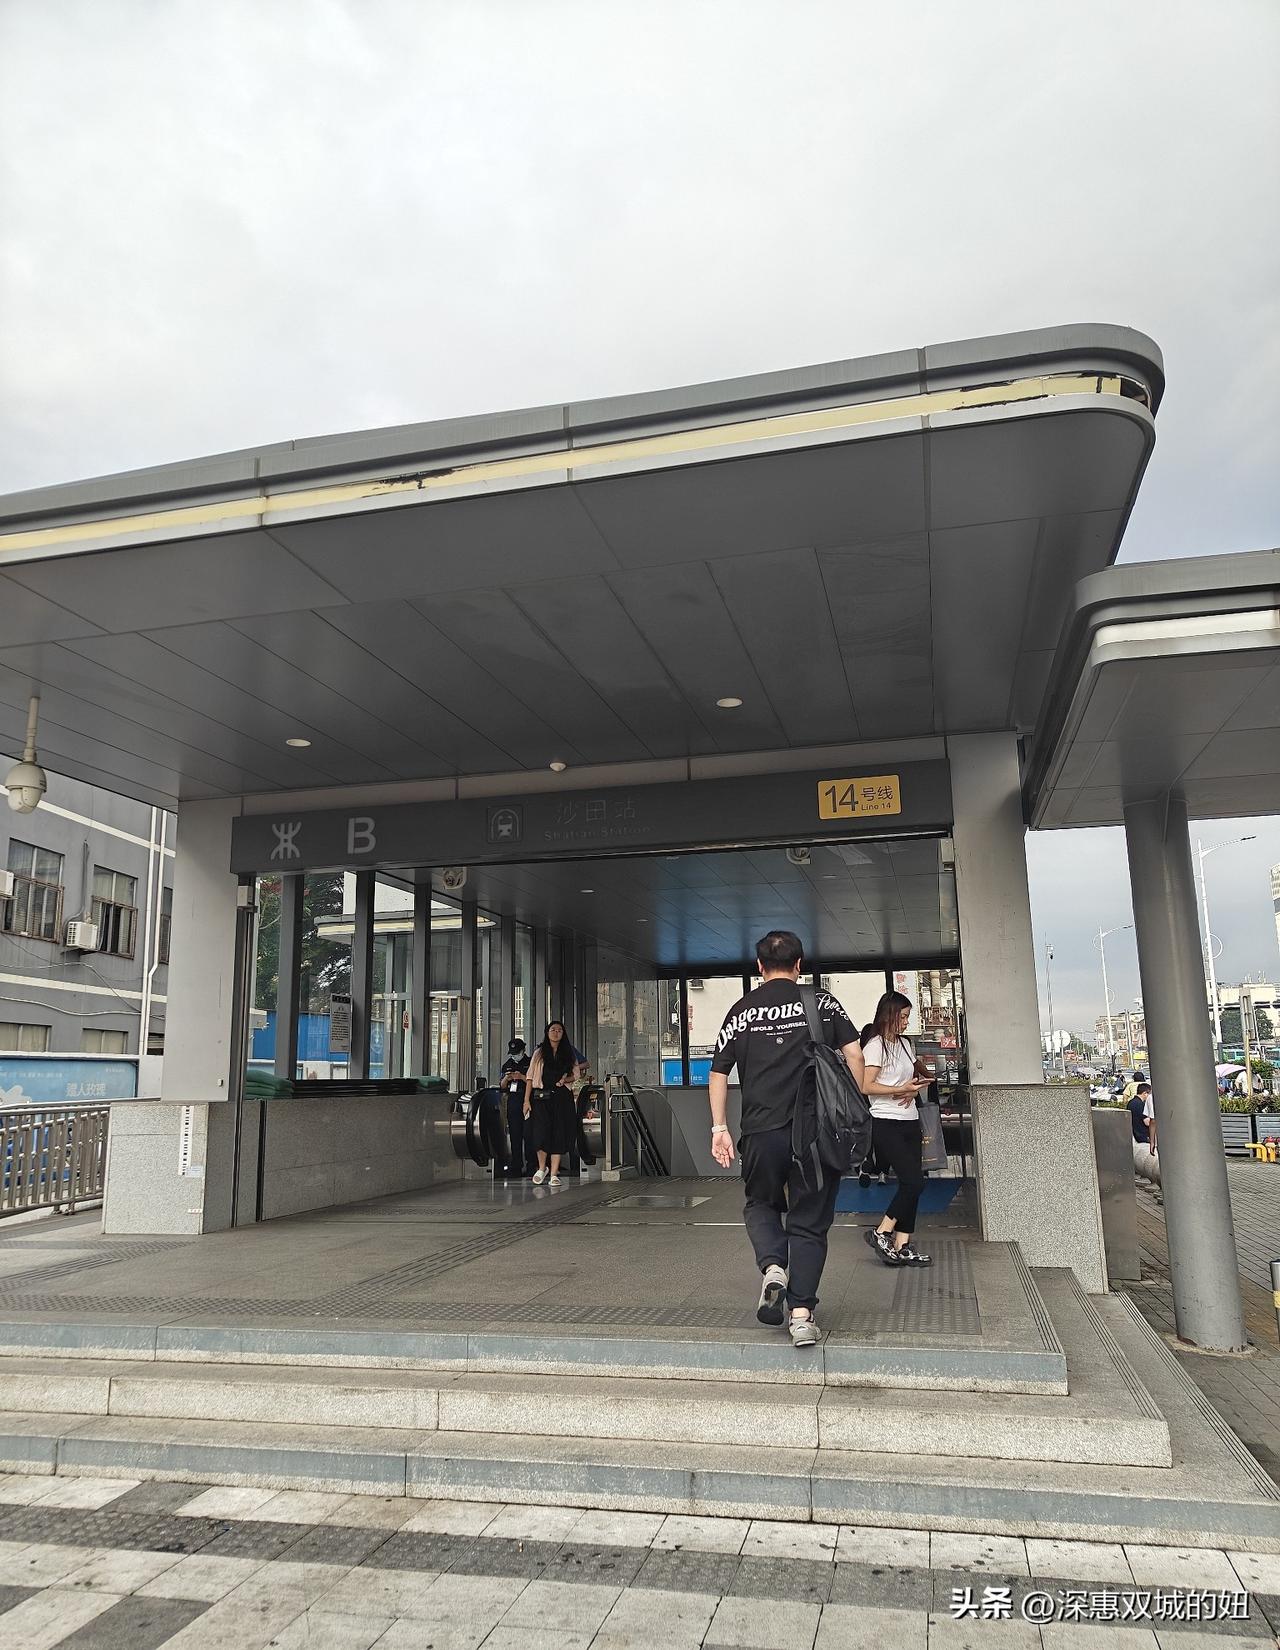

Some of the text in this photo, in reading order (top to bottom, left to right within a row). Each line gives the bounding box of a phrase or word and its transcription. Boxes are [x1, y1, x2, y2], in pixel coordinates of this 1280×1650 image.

[552, 797, 637, 825] 沙田站
[861, 803, 879, 811] Line
[347, 816, 377, 855] B
